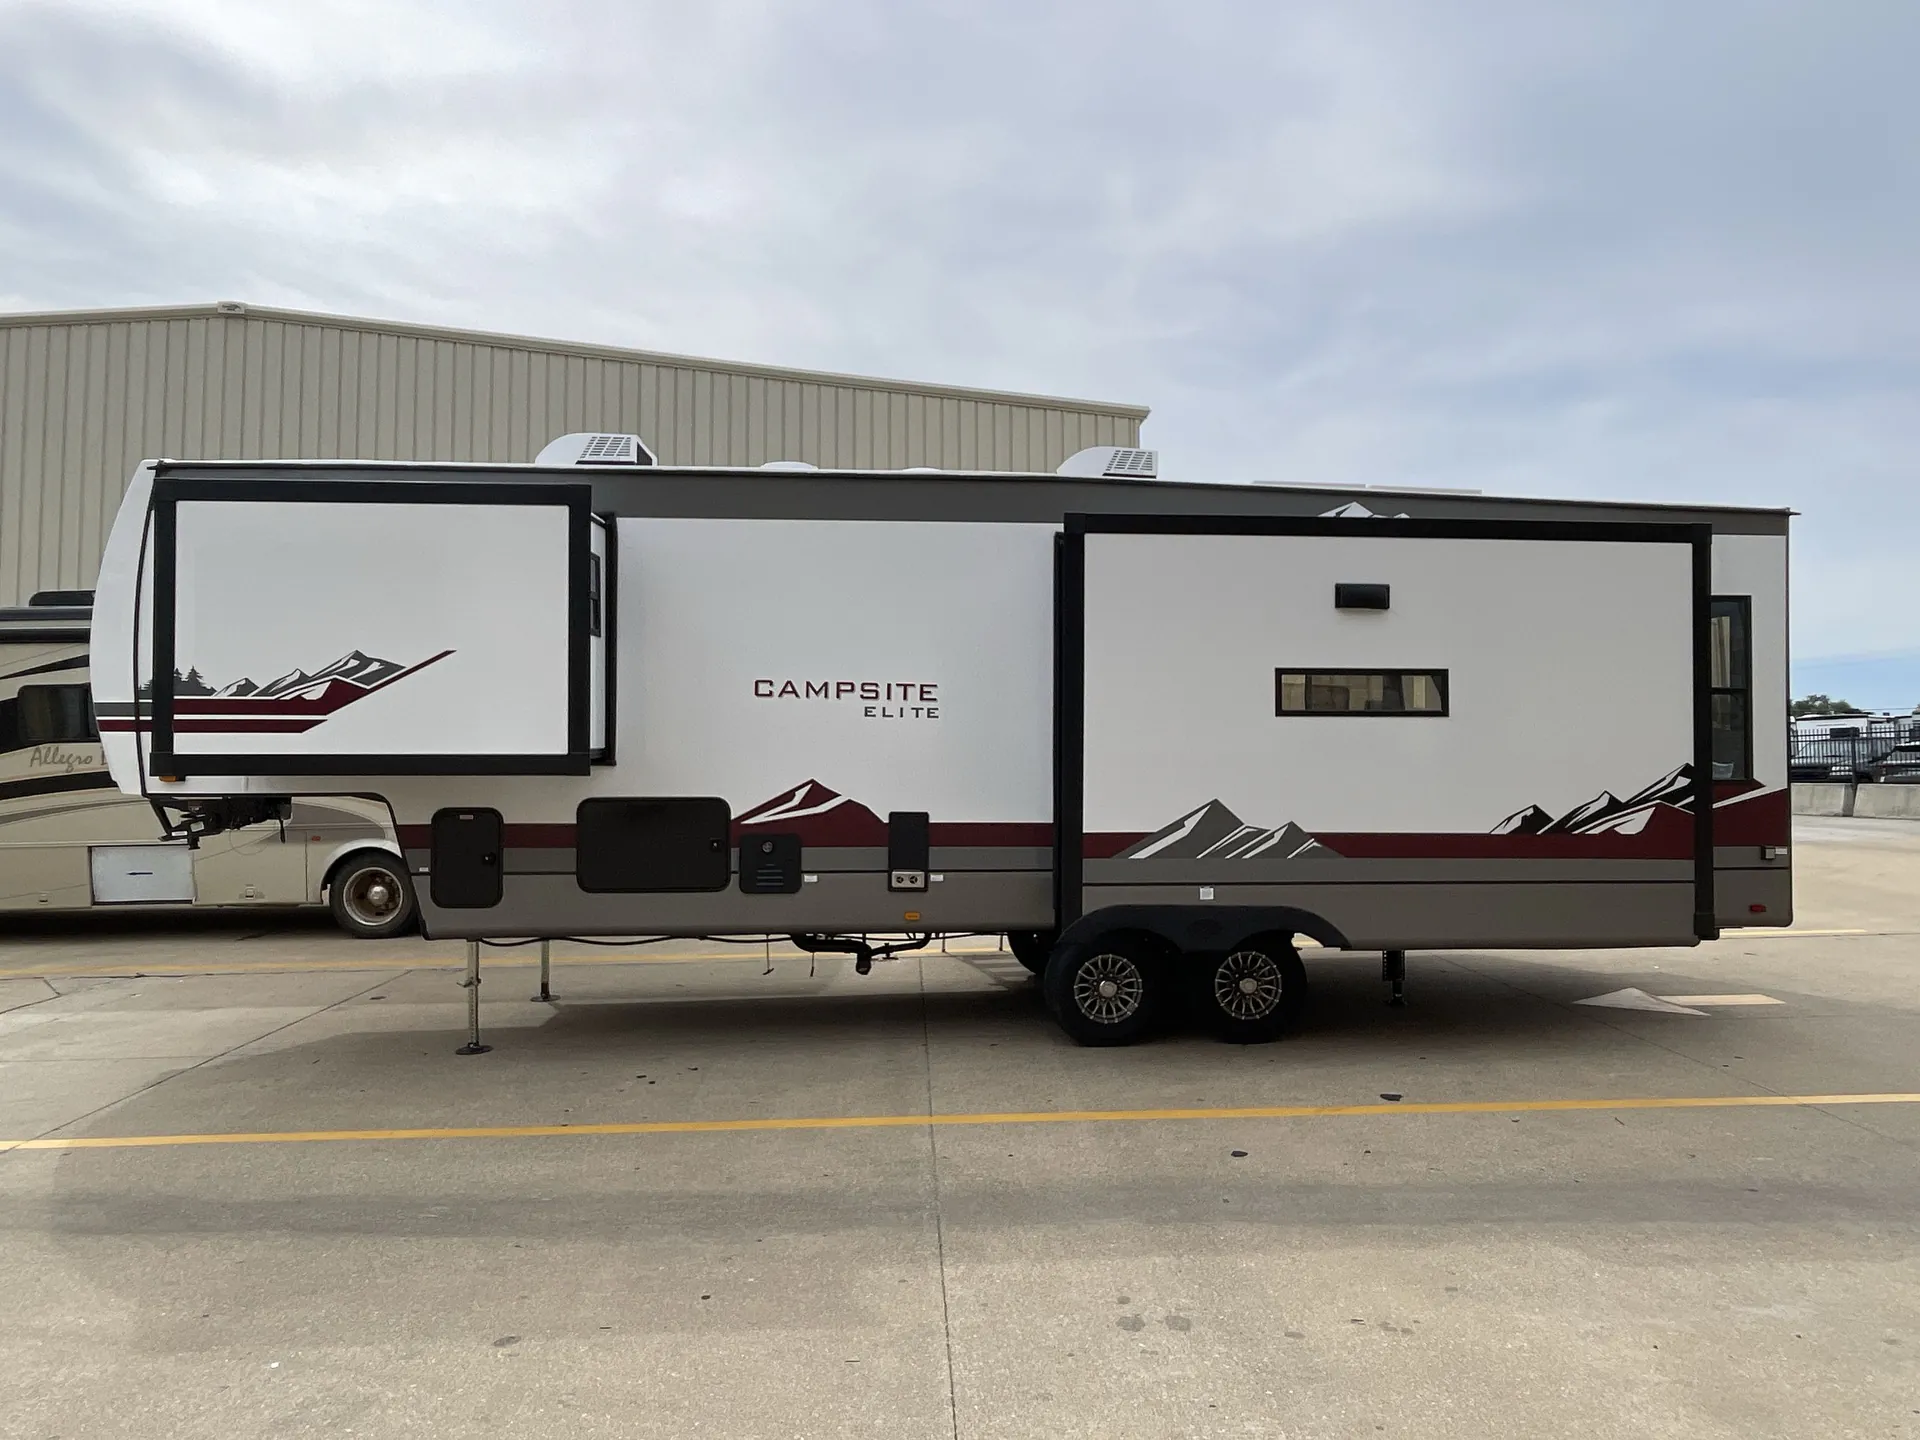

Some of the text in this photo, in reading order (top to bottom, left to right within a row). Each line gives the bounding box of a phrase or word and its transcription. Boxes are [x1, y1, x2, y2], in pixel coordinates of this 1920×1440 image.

[754, 680, 938, 702] CAMPSITE
[864, 706, 940, 719] ELITE
[30, 747, 93, 773] Allegro
